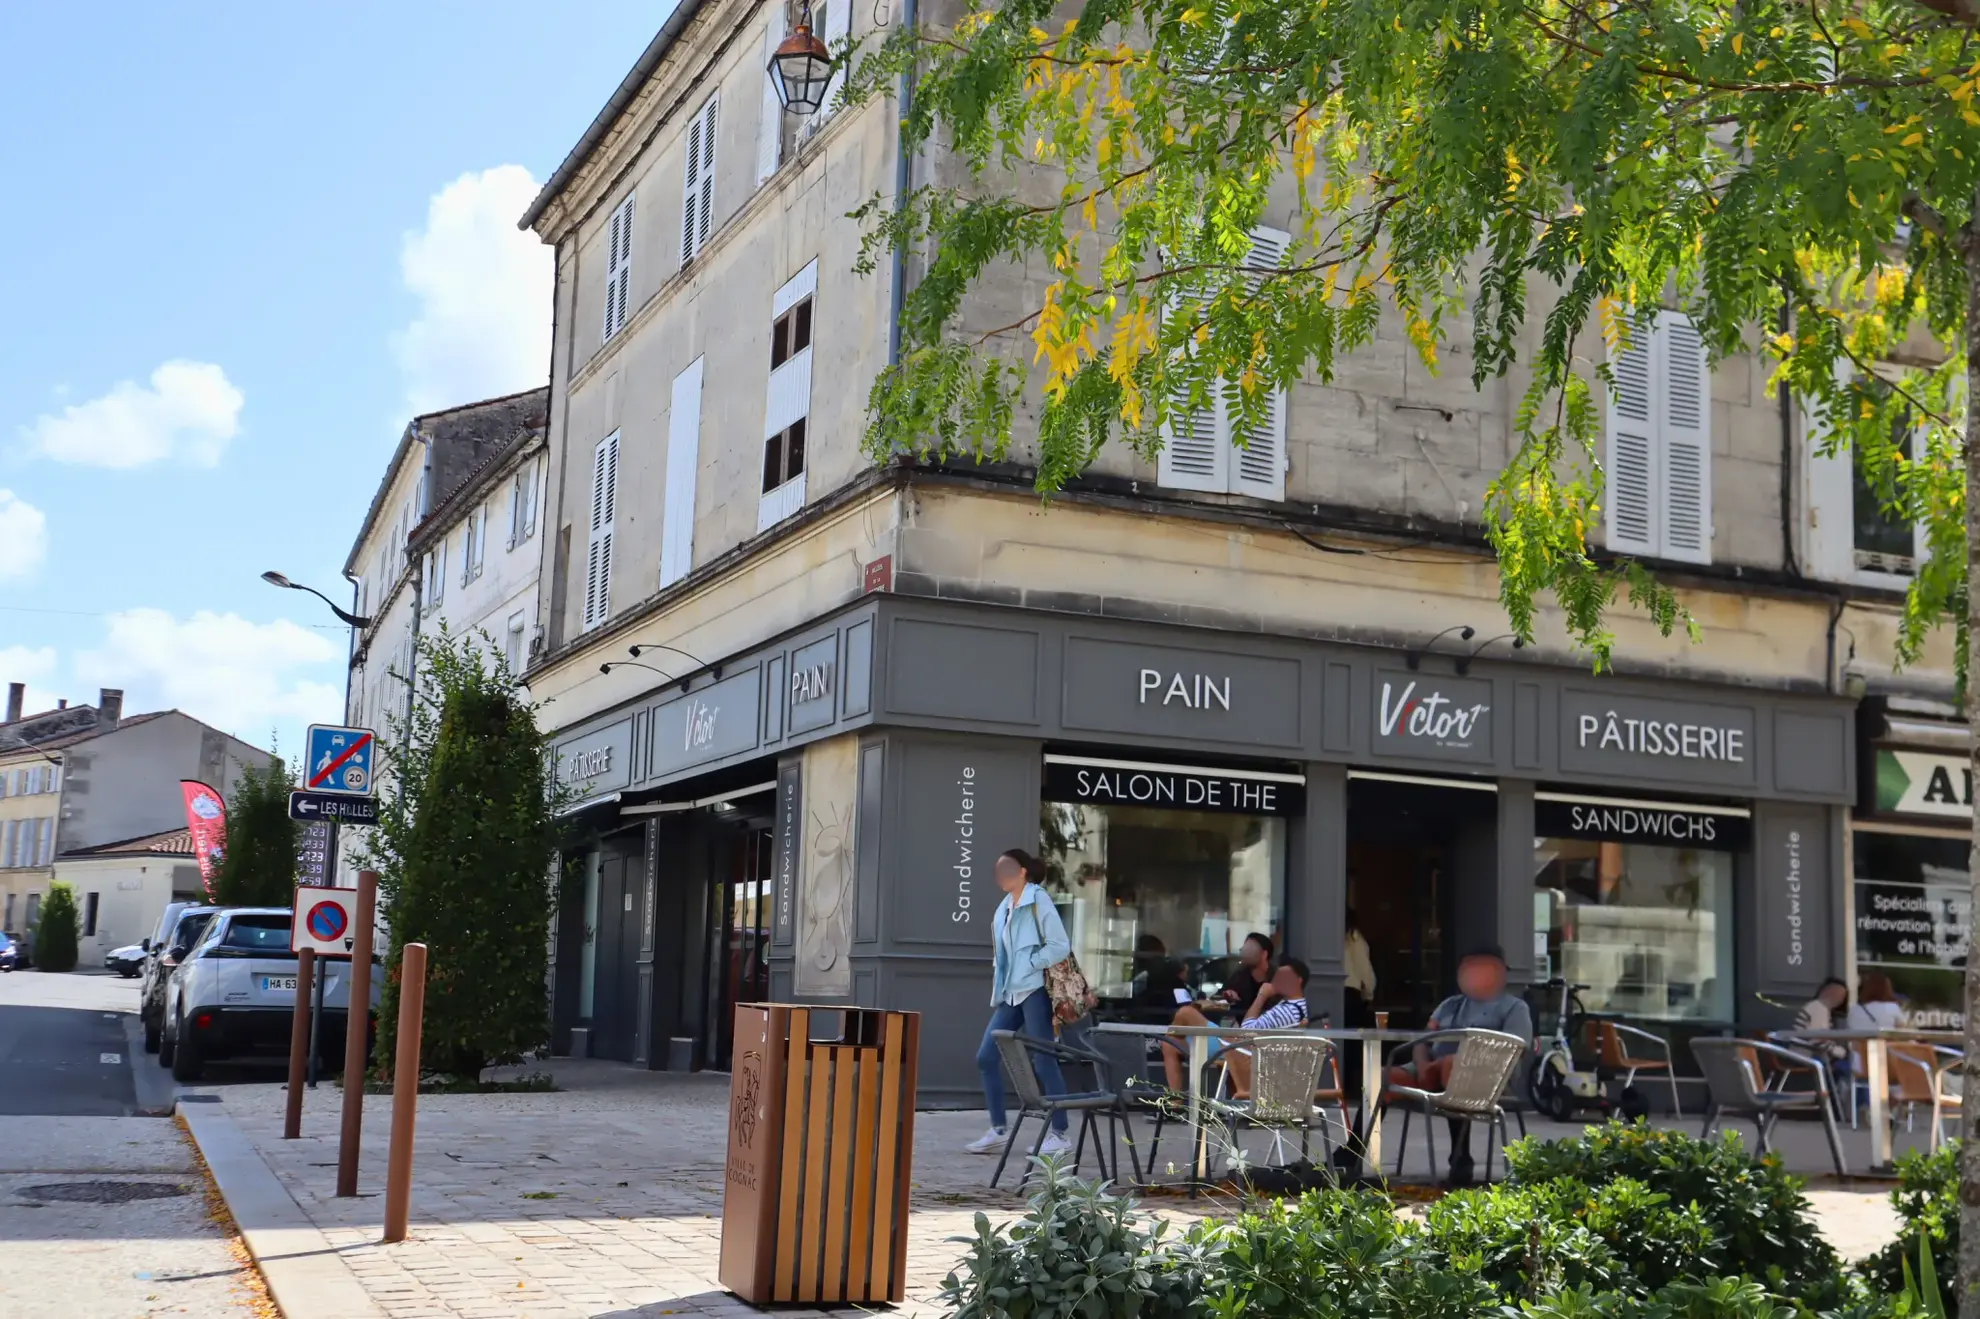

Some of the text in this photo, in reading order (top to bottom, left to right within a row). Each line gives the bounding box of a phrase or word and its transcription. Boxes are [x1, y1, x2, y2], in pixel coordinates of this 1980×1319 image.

[792, 661, 826, 705] PAIN
[1140, 669, 1230, 711] PAIN
[1380, 681, 1472, 738] Victor
[1580, 710, 1744, 762] PÂTISSERIE
[349, 773, 362, 783] 20
[1077, 770, 1277, 811] SALON DE THE
[320, 801, 338, 815] LES
[1571, 806, 1716, 841] SANDWICHS
[781, 784, 794, 925] Sandwicherie
[952, 766, 976, 923] Sandwicherie
[1784, 831, 1802, 965] Sandwicherie
[1857, 914, 1931, 933] rénovation
[1897, 939, 1916, 954] de
[728, 1168, 756, 1191] COGNAC
